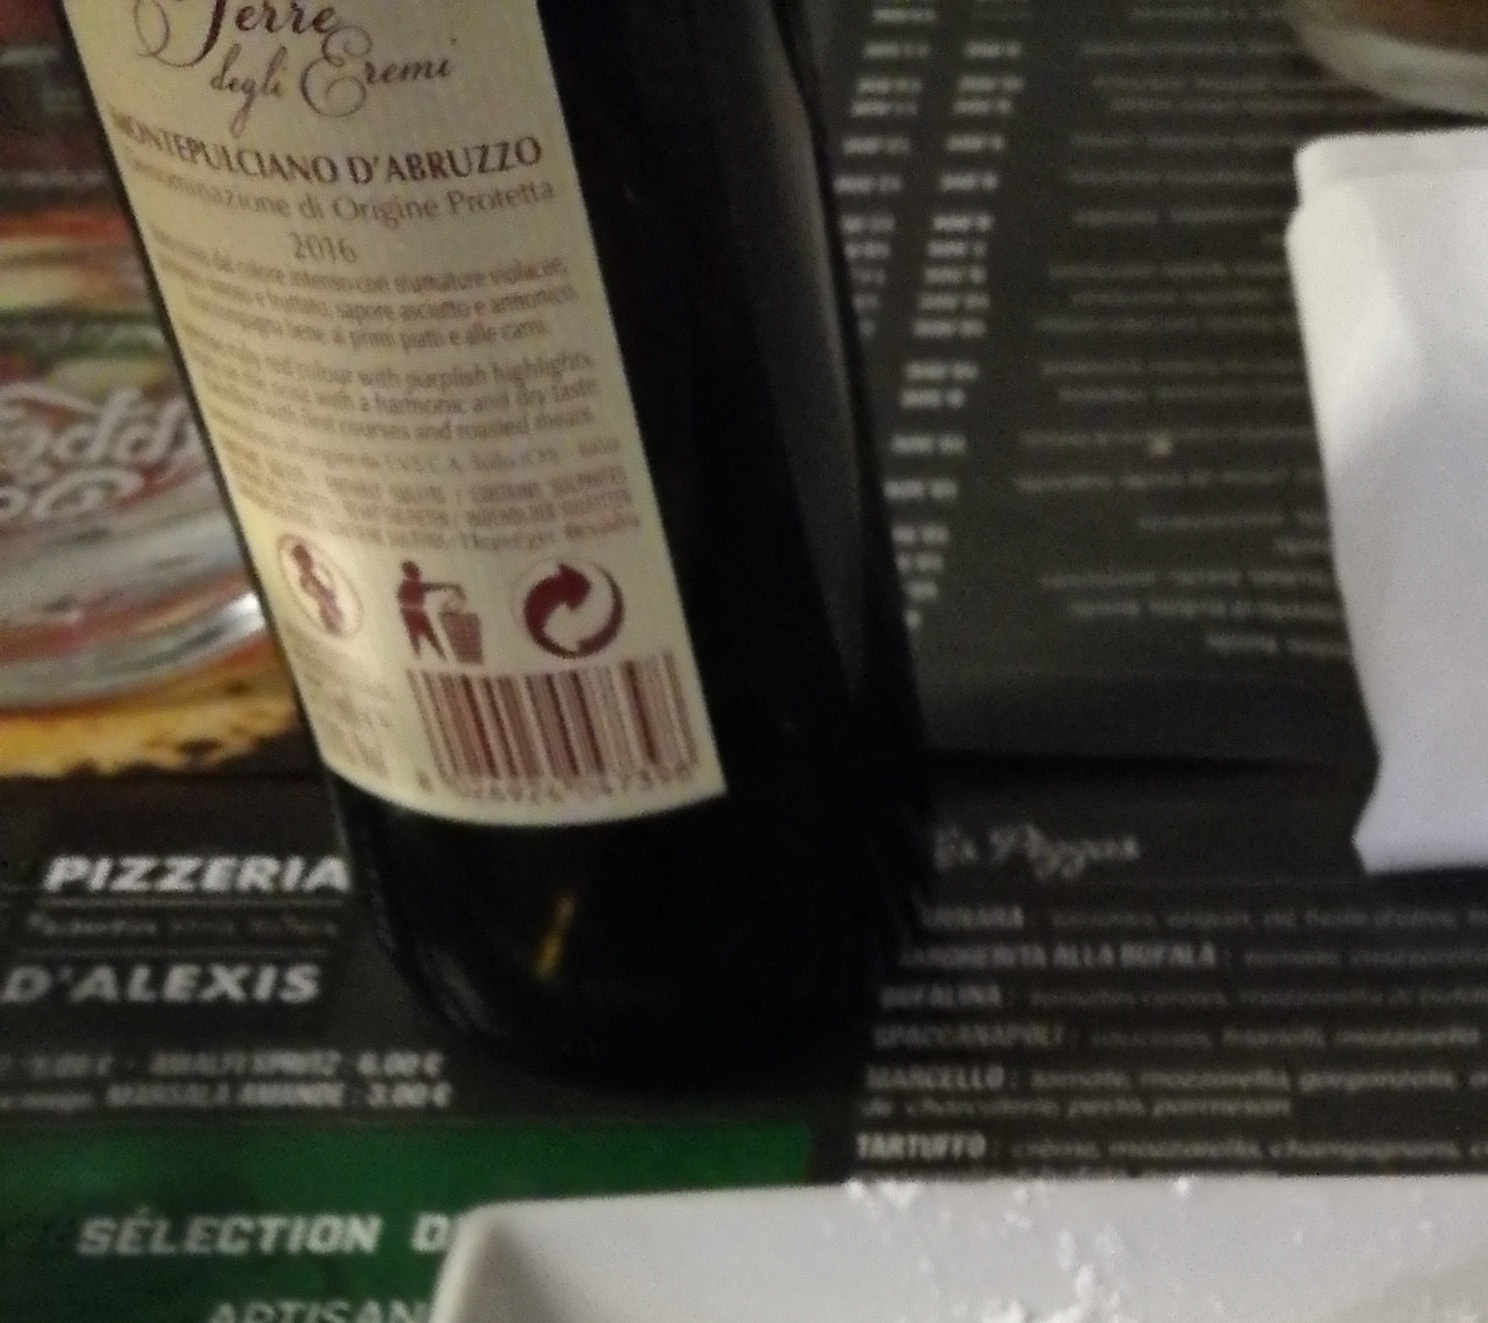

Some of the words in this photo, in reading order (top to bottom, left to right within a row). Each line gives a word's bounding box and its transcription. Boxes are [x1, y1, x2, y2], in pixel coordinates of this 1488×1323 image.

[209, 44, 289, 139] degli
[301, 26, 459, 118] Eremi
[110, 105, 339, 184] MONTEPULCIANO
[350, 136, 543, 184] D'ABRUZZO
[300, 195, 325, 218] di
[332, 195, 441, 228] Origine
[449, 180, 556, 215] Protetta
[293, 230, 357, 263] 2016
[42, 855, 351, 894] PIZZERIA
[1, 963, 322, 1004] D'ALEXIS
[76, 1204, 384, 1256] SÉLECTION
[411, 1213, 457, 1253] D
